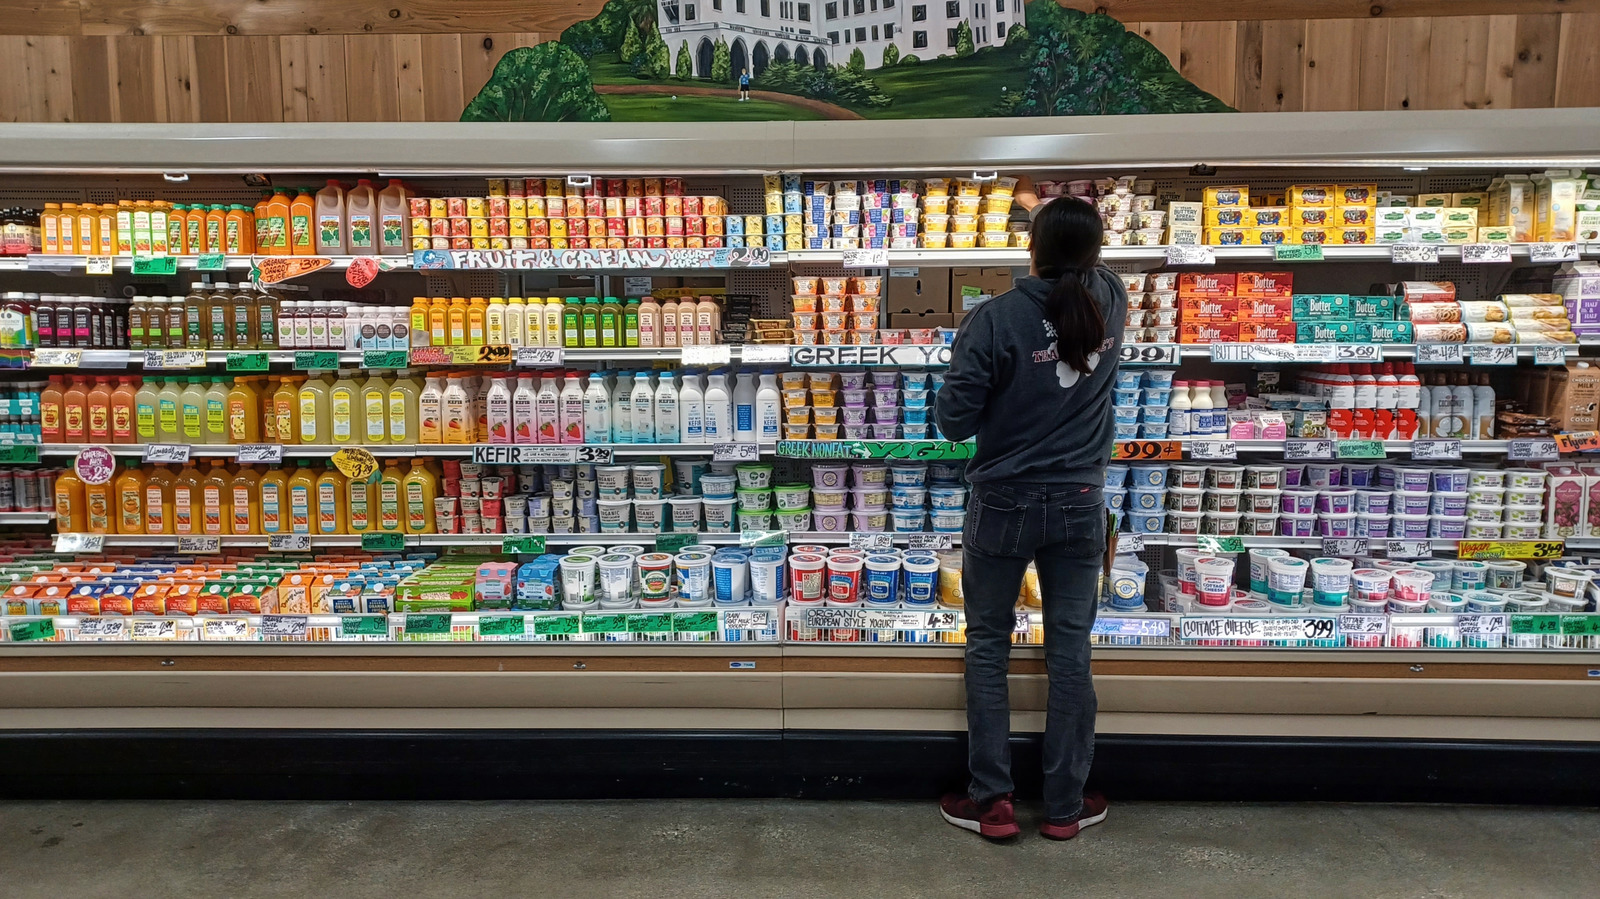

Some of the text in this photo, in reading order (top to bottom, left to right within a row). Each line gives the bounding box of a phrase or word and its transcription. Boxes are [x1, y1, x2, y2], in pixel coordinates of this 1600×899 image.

[539, 249, 556, 268] &
[561, 249, 664, 268] CREAM
[666, 249, 714, 259] YOGURT
[263, 258, 288, 267] ORGANIC
[264, 263, 292, 274] CARROT
[266, 274, 286, 282] JUICE
[1196, 276, 1218, 289] Butter
[1254, 276, 1275, 289] Butter
[1200, 301, 1222, 314] Butter
[1254, 301, 1275, 313] Butter
[1310, 300, 1332, 312] Butter
[1355, 300, 1376, 313] Butter
[1200, 327, 1221, 339] Butter
[1256, 326, 1278, 339] Butter
[1315, 326, 1336, 339] Butter
[1372, 326, 1393, 339] Butter
[794, 347, 899, 364] GREEK
[1216, 344, 1295, 361] BUTTER QUARTERS
[475, 447, 521, 463] KEFIR
[777, 442, 810, 458] GREEK
[866, 442, 977, 459] YOGU
[1461, 542, 1491, 556] Vegan
[808, 610, 867, 618] ORGANIC
[928, 613, 954, 628] 4.39
[808, 618, 897, 628] EUROPEAN STYLE YOGURT
[1183, 620, 1224, 637] COTTAGE
[1224, 619, 1259, 636] CHEESE
